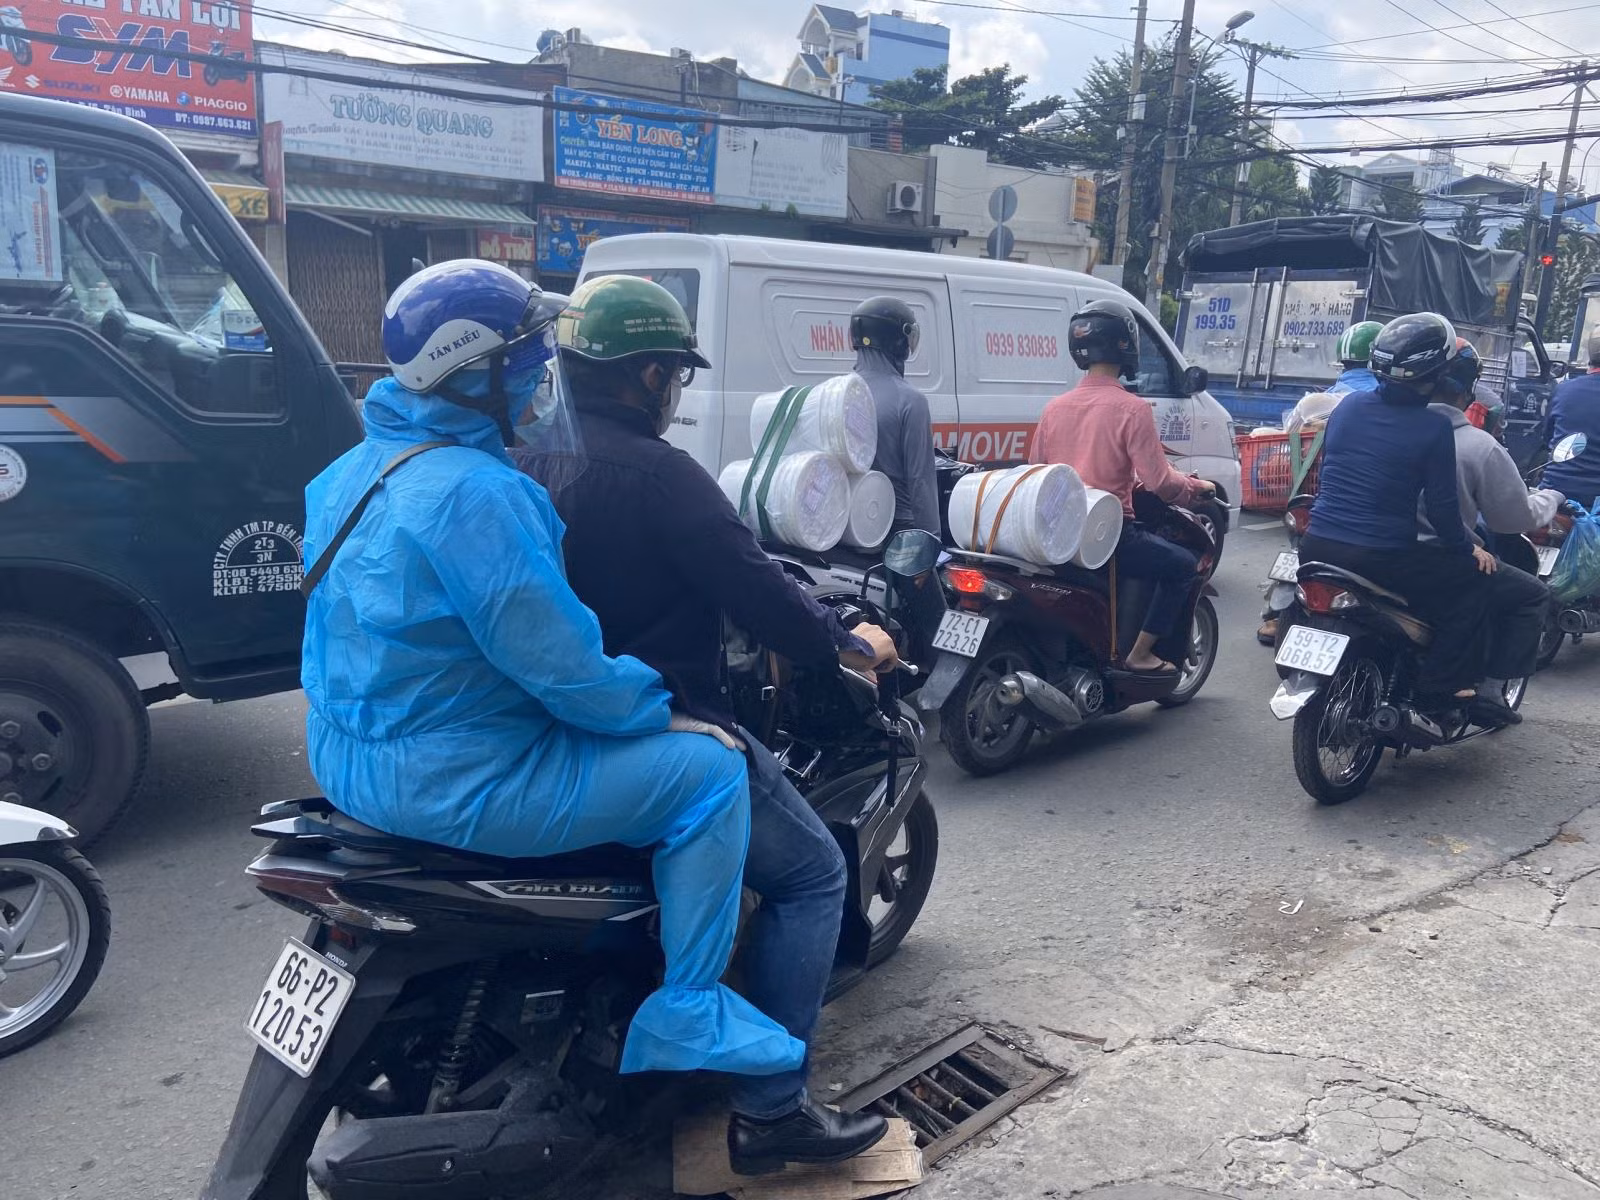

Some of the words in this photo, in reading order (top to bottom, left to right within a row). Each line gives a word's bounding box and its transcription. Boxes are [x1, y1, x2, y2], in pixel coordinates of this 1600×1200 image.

[192, 1, 241, 33] LỢI
[50, 13, 192, 78] SYM
[123, 86, 169, 103] YAMAHA
[194, 96, 247, 111] PIAGGIO
[330, 92, 411, 128] TƯỜNG
[416, 106, 494, 138] QUANG
[595, 114, 633, 142] YẾN
[637, 125, 682, 148] LONG
[565, 158, 592, 168] MAKITA
[1208, 297, 1231, 313] 51D
[1195, 314, 1237, 330] 199.35
[1284, 320, 1345, 336] 0902.733.689
[428, 345, 452, 362] TÂN
[453, 329, 481, 352] KIỀU
[985, 332, 1014, 356] 0939
[1017, 333, 1058, 358] 830838
[931, 430, 1028, 462] AMOVE
[243, 521, 260, 535] TM
[262, 520, 275, 532] TP
[219, 528, 244, 552] TNHH
[213, 551, 227, 570] CTY
[256, 552, 272, 563] 3N
[213, 576, 253, 588] KLBT:
[258, 573, 303, 585] 2255K
[250, 566, 280, 577] 5449
[283, 565, 304, 574] 630
[213, 586, 253, 597] KLTB:
[257, 582, 302, 593] 4750K
[945, 613, 981, 635] 72-C1
[934, 629, 979, 654] 723.26
[1294, 629, 1339, 654] 59-T2
[1280, 646, 1337, 671] 068.57
[507, 883, 562, 893] AIR
[277, 951, 339, 1017] 66-P2
[253, 990, 323, 1065] 120.53
